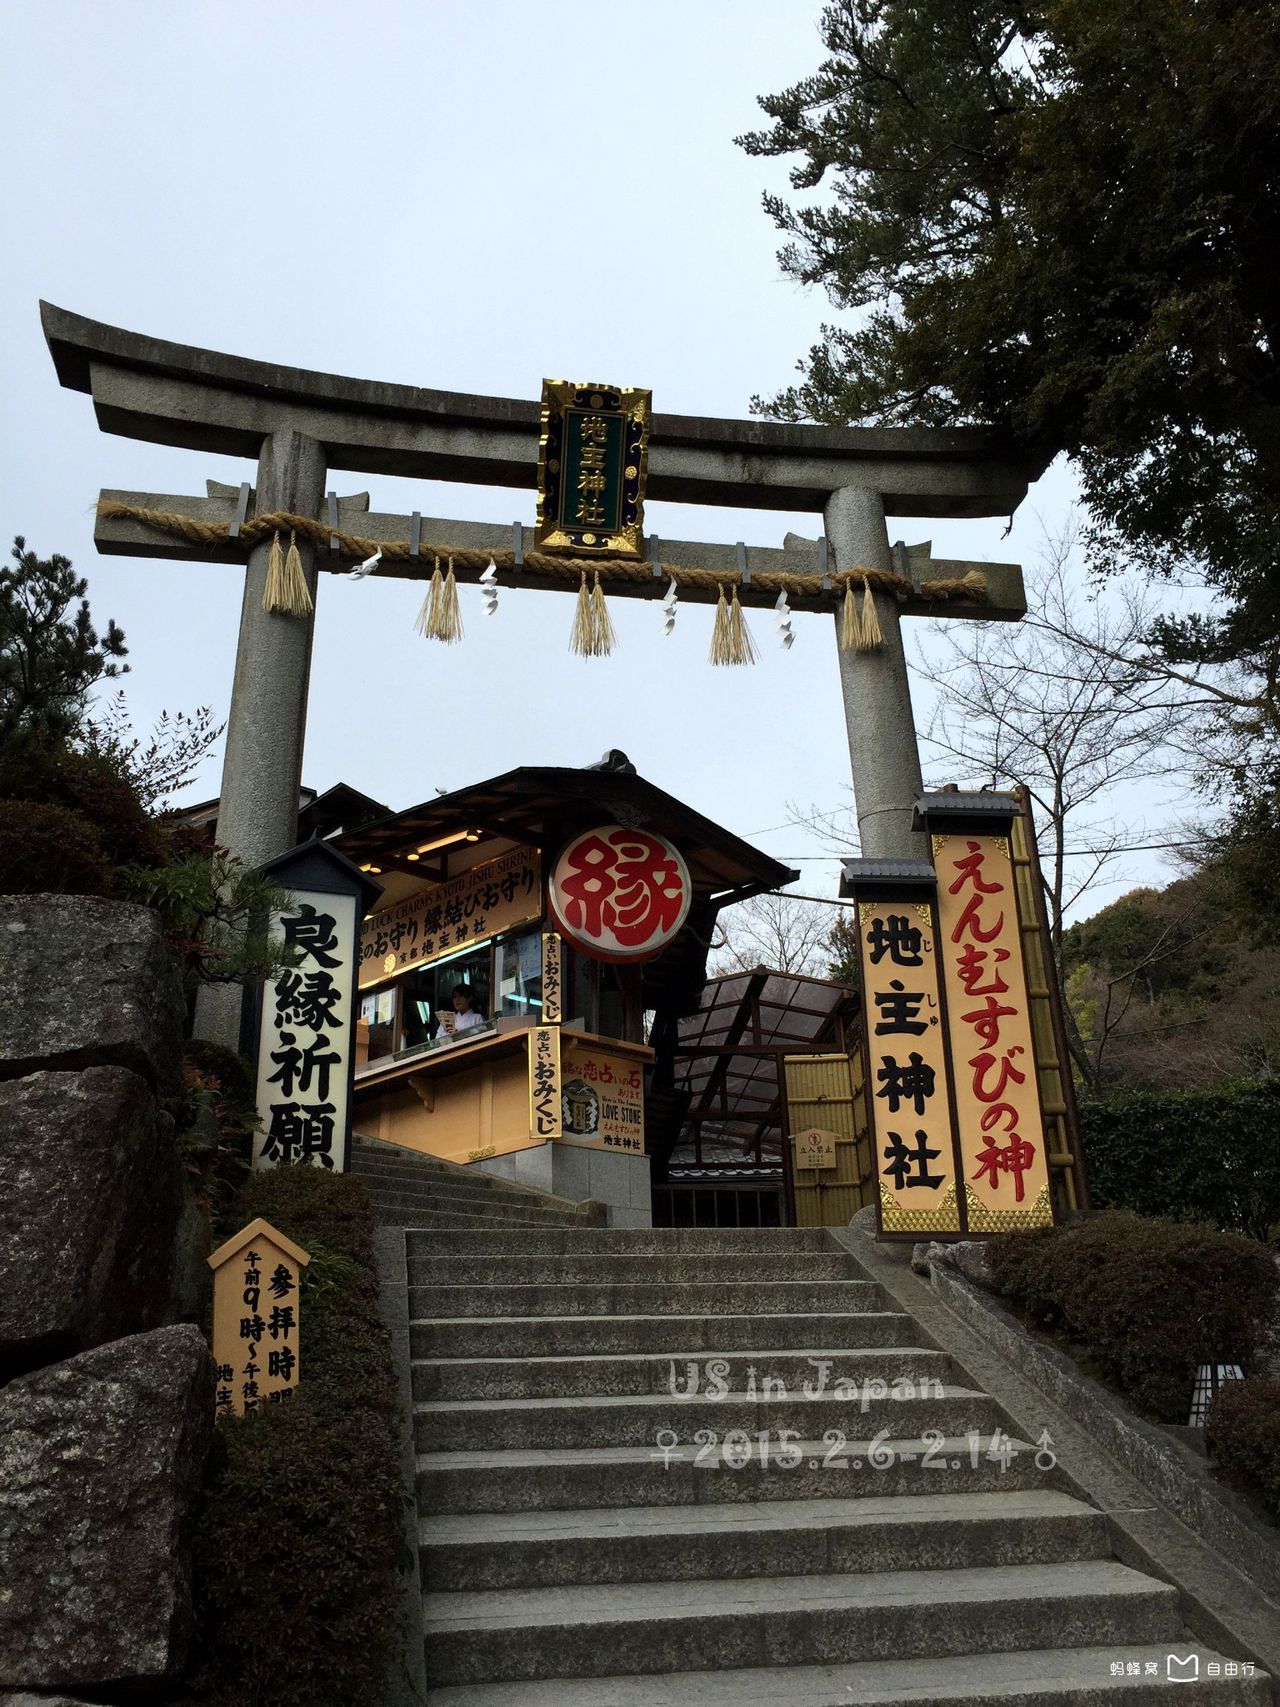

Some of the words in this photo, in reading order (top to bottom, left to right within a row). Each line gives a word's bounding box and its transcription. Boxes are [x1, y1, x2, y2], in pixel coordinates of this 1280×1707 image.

[422, 916, 487, 957] 地主神社
[559, 829, 684, 948] 縁
[259, 903, 345, 1169] 良縁祈願
[866, 913, 947, 1191] 地主神社
[948, 840, 1036, 1203] えんむすびの神
[533, 1030, 558, 1135] 恋占いおみくじ
[602, 1104, 618, 1120] LOVE
[621, 1106, 641, 1124] STONE
[603, 1135, 641, 1150] 地主神社
